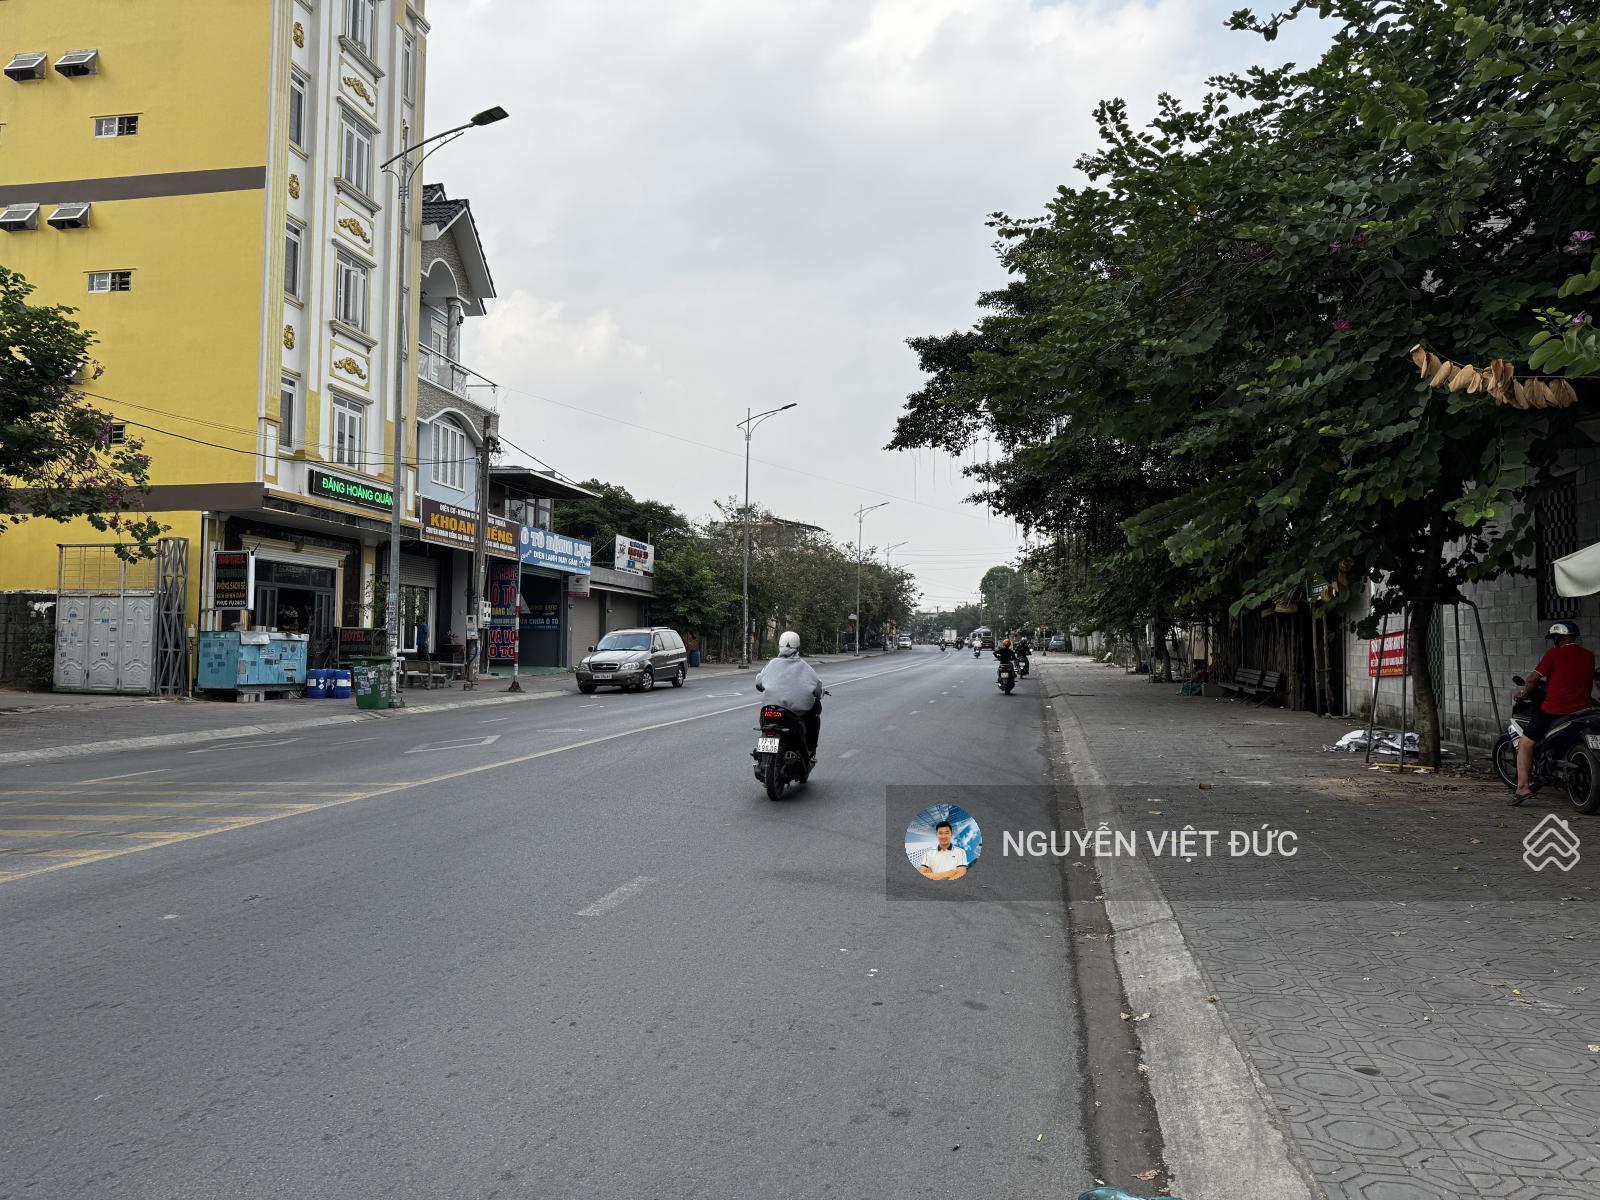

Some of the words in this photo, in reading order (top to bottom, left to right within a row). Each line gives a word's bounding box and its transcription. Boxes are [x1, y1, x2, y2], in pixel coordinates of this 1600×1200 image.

[430, 512, 475, 535] KHOAN
[487, 525, 513, 545] IẾNG
[520, 526, 530, 545] Ô
[340, 630, 366, 641] HOTEL
[489, 628, 503, 644] VÁ
[489, 643, 498, 658] Ô
[499, 643, 515, 658] TÔ
